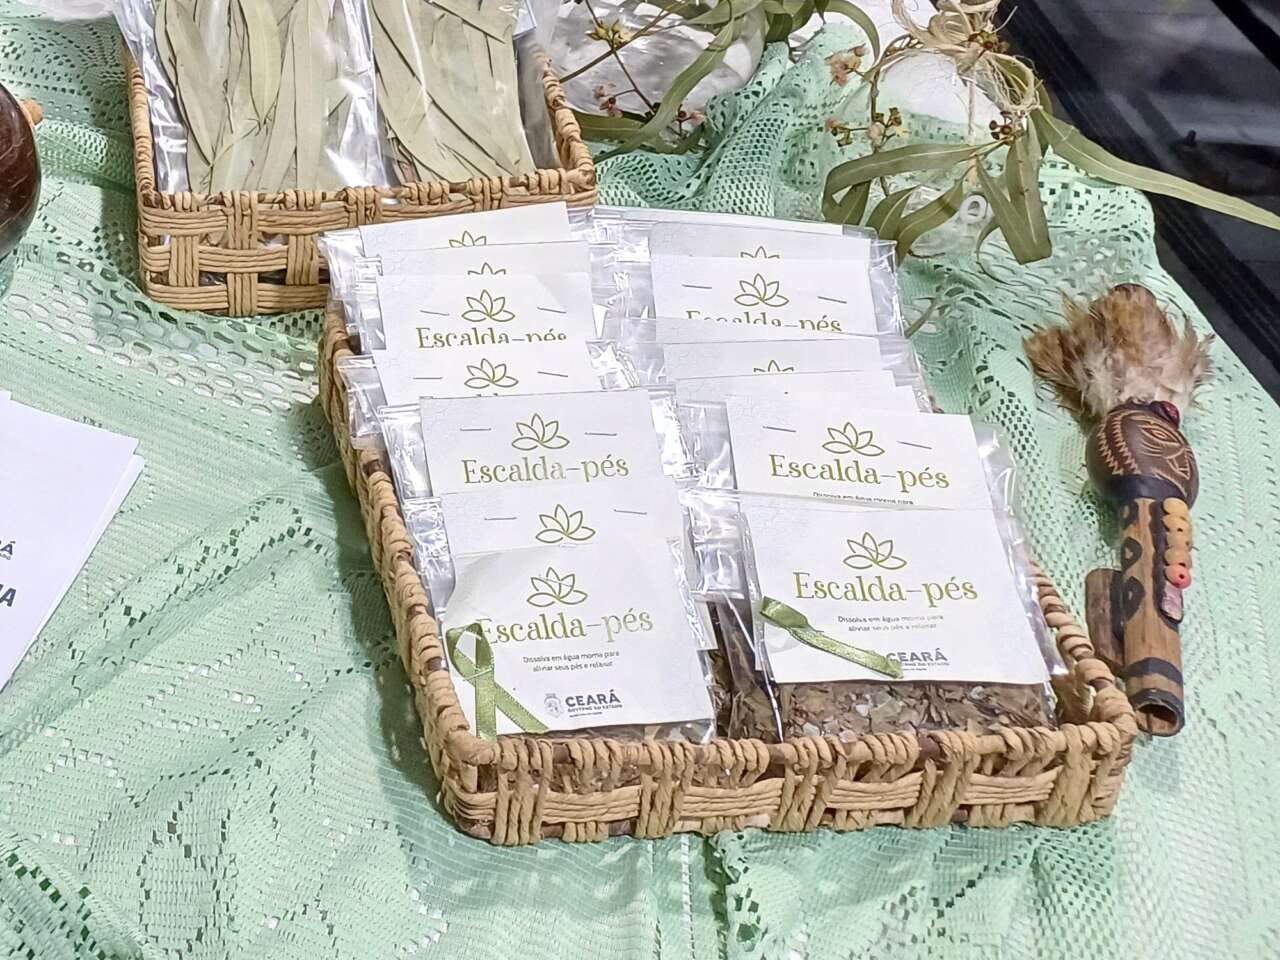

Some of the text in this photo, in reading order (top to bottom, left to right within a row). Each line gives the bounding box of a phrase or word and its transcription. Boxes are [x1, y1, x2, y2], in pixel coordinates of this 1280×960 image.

[461, 453, 631, 485] Escalda-pés
[769, 453, 950, 494] Escalda-pés
[792, 571, 979, 609] Escalda-pés
[477, 607, 655, 644] Escalda-pés
[886, 647, 948, 663] CEARÁ
[565, 688, 621, 708] CEARÁ
